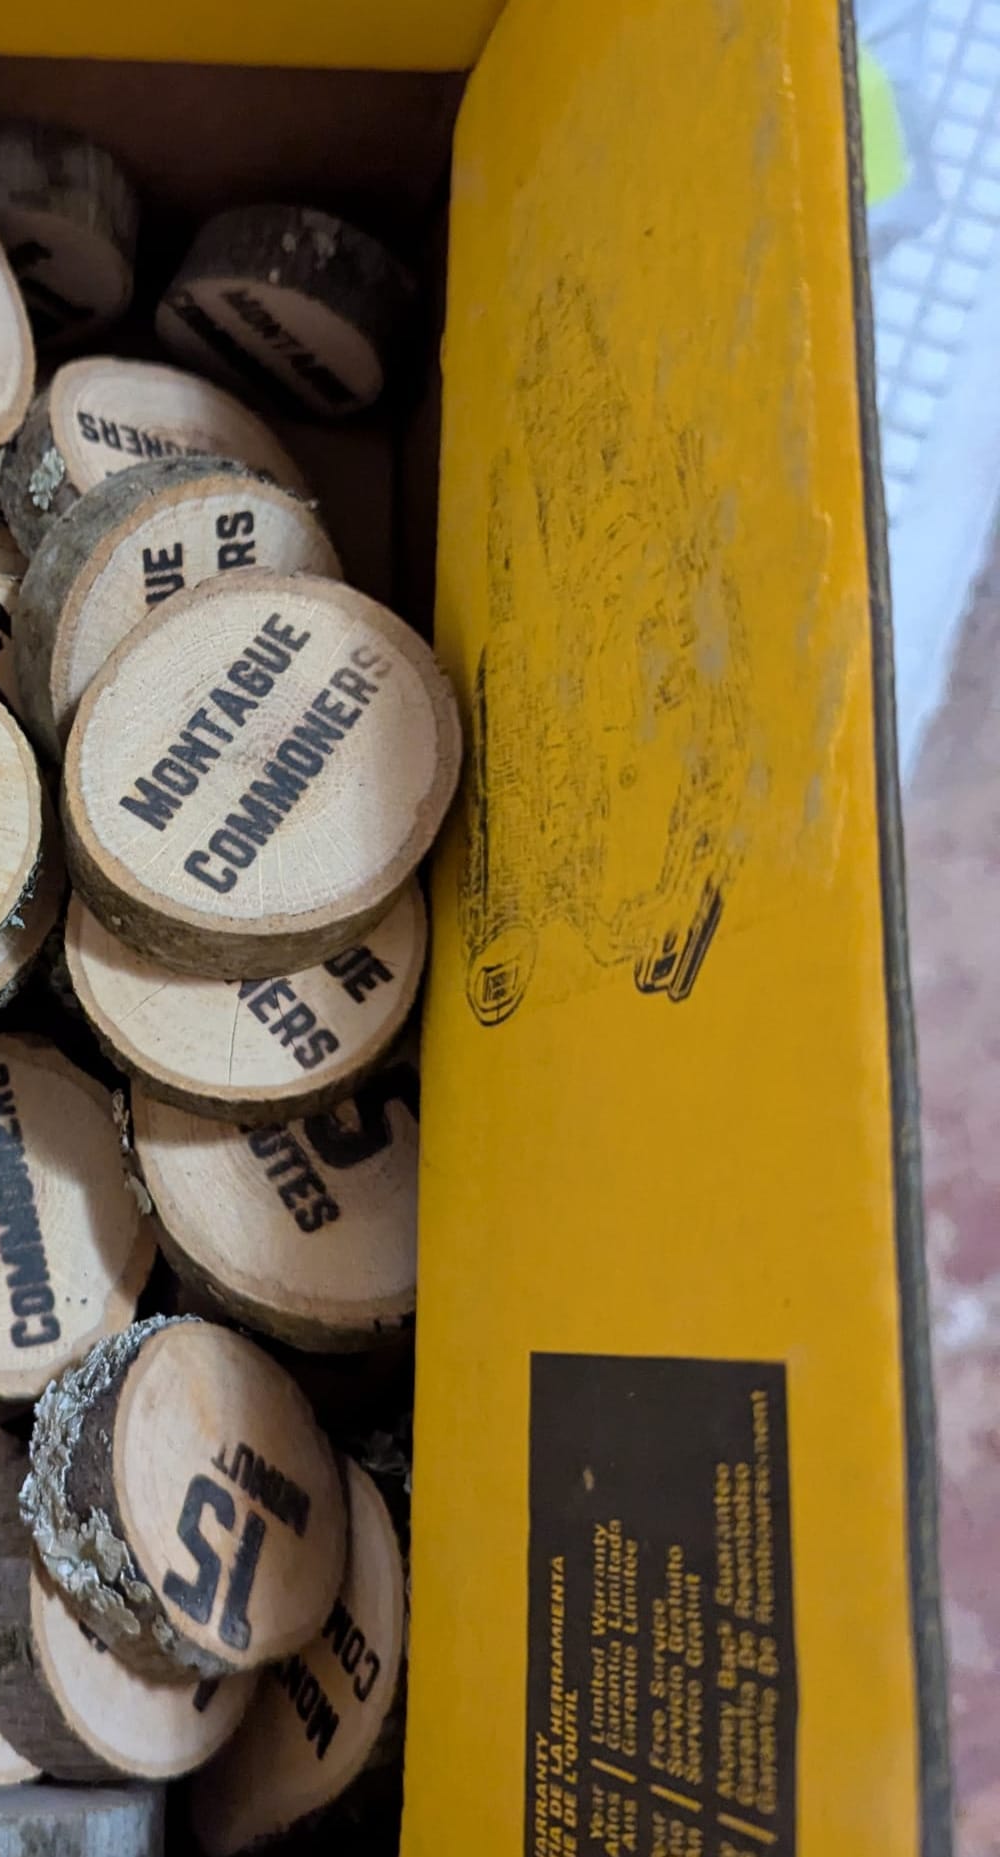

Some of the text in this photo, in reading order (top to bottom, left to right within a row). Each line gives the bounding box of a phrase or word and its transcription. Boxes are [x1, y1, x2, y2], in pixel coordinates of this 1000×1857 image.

[118, 611, 314, 834] MONTAGUE
[183, 641, 395, 895] COMMONERS
[242, 1120, 341, 1234] UTES
[162, 1473, 265, 1652] 15
[591, 1523, 608, 1636] Warranty
[607, 1520, 622, 1629] Limitada
[550, 1556, 564, 1734] HERRAMIENTA
[590, 1648, 606, 1744] Limited
[550, 1744, 562, 1775] LA
[564, 1689, 578, 1784] L'OUTIL
[550, 1784, 562, 1818] DE
[564, 1792, 577, 1828] DE
